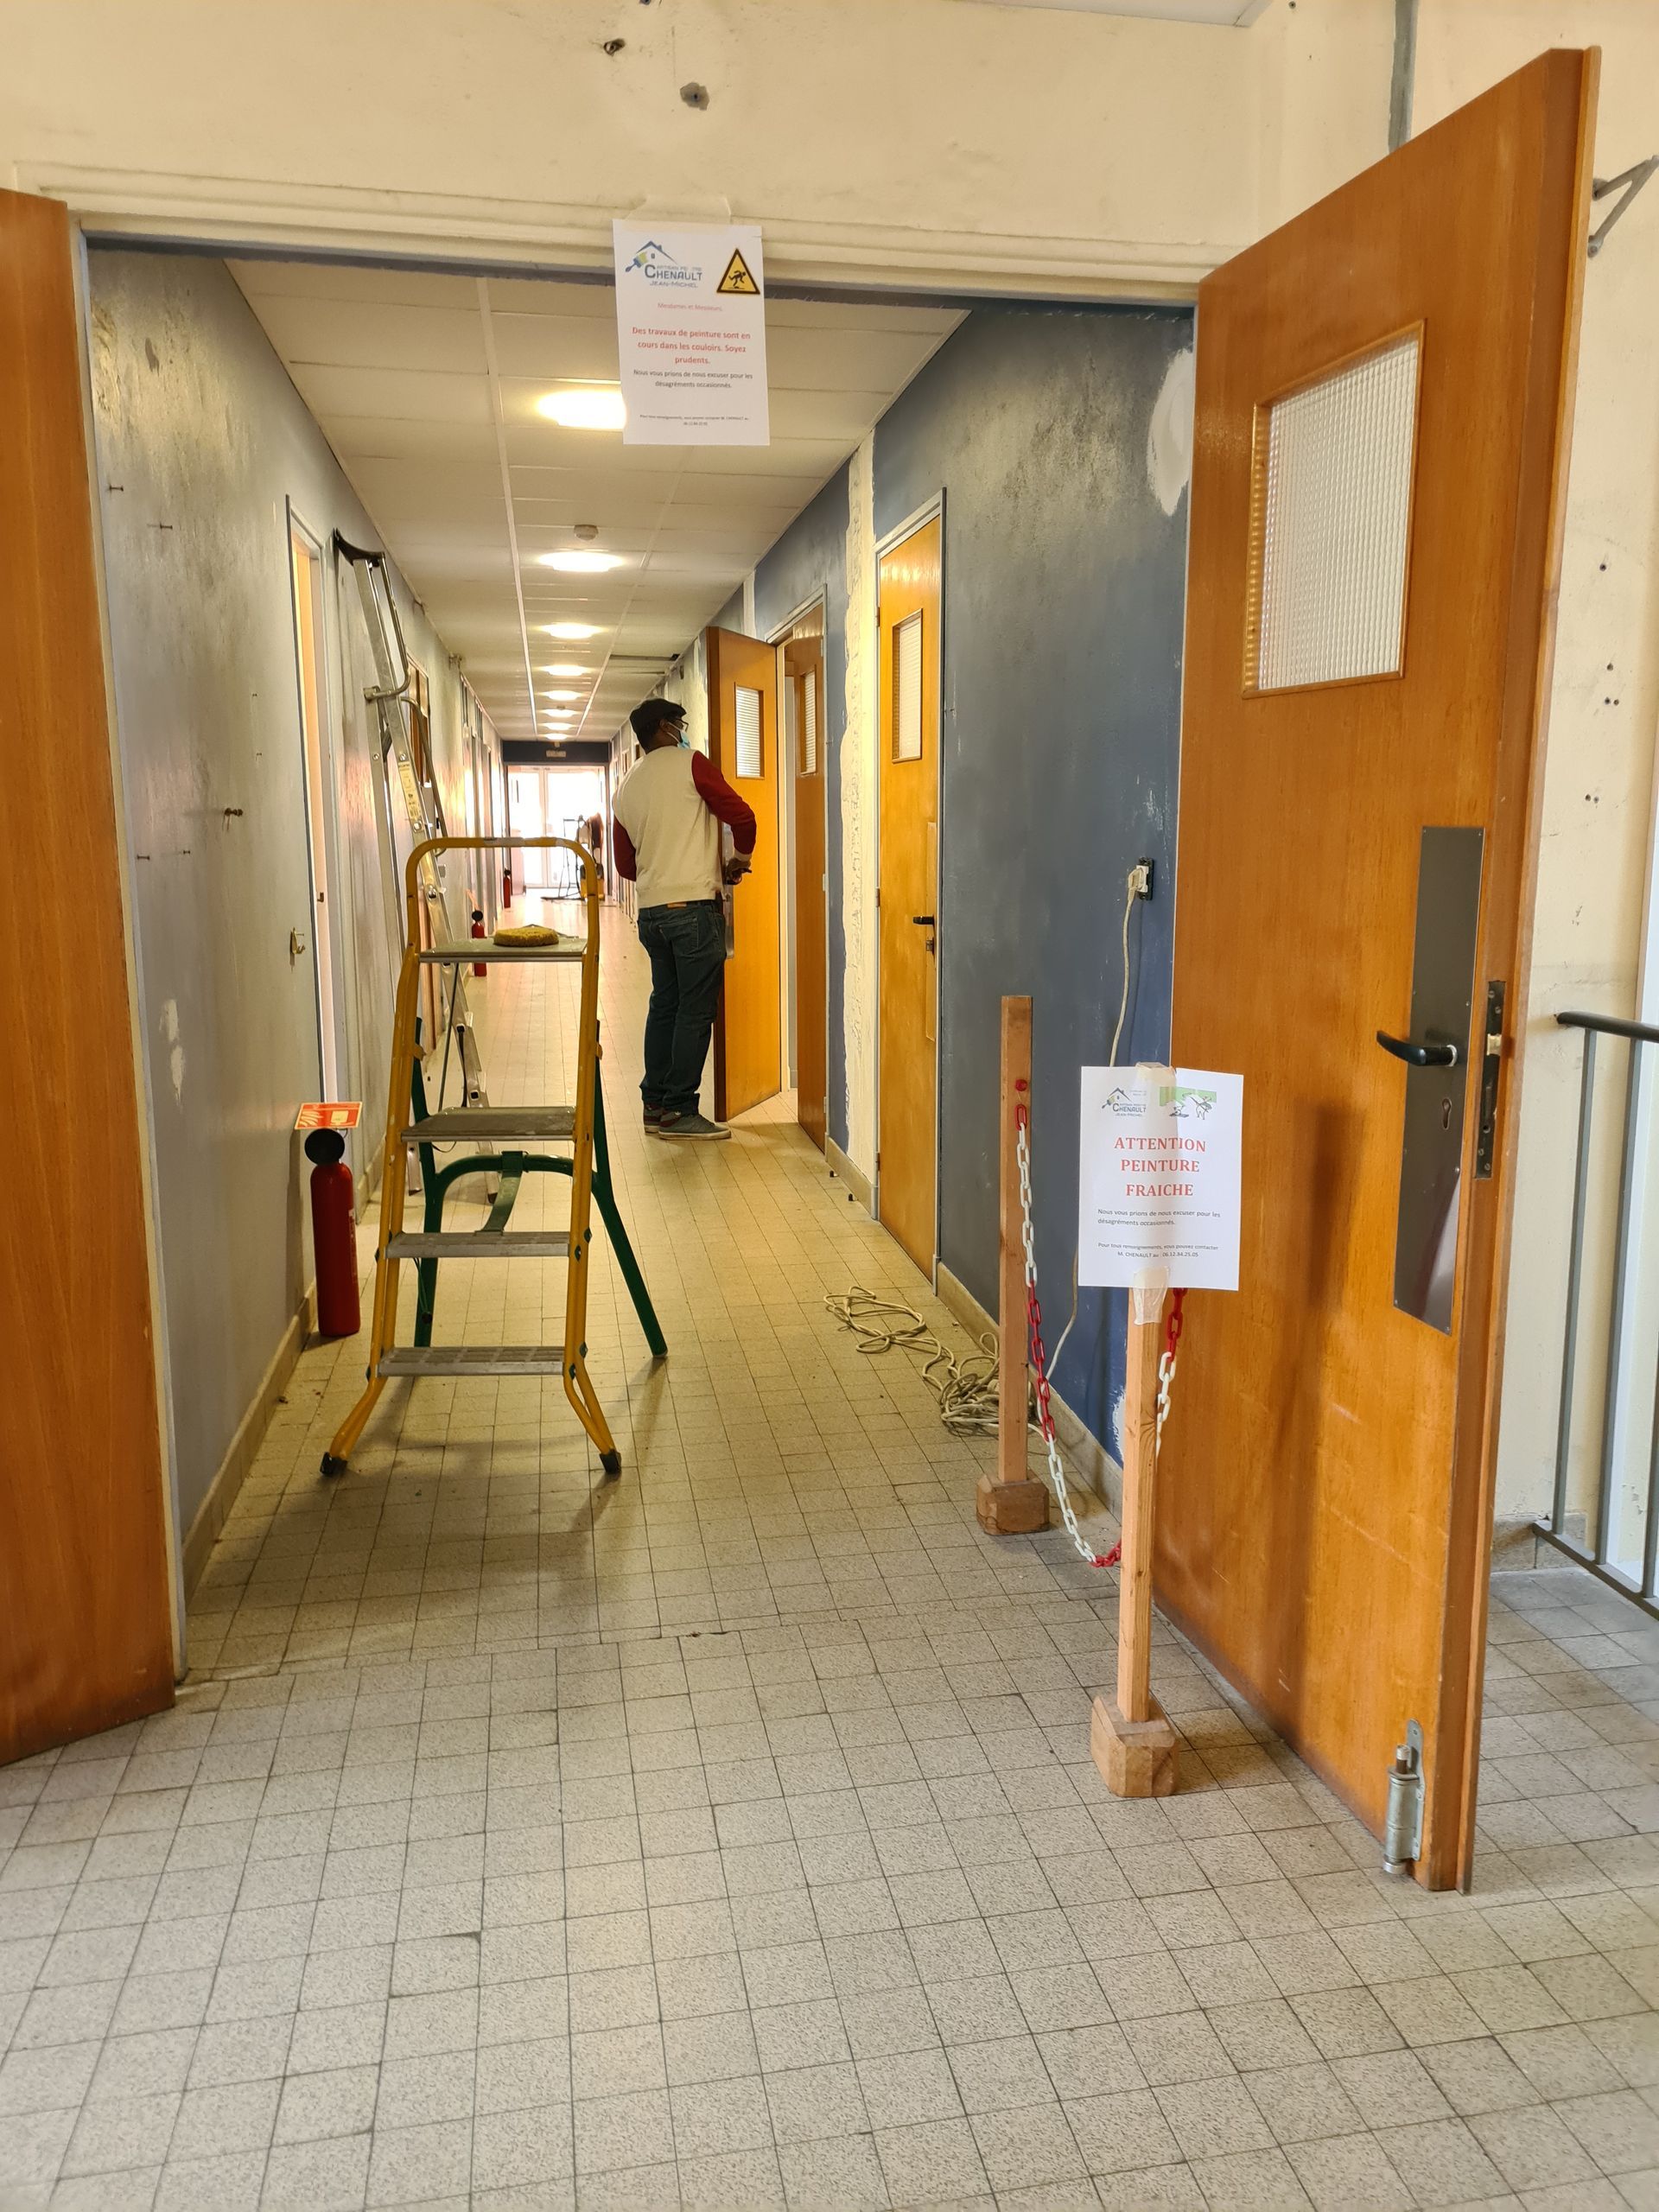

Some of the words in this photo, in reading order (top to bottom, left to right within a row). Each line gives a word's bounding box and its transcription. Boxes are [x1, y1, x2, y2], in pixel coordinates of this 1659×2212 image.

[645, 264, 702, 281] CHENAULT
[1112, 1103, 1147, 1113] CHENAULT
[1114, 1137, 1206, 1152] ATTENTION
[1121, 1159, 1200, 1172] PEINTURE
[1126, 1184, 1193, 1197] FRAICHE
